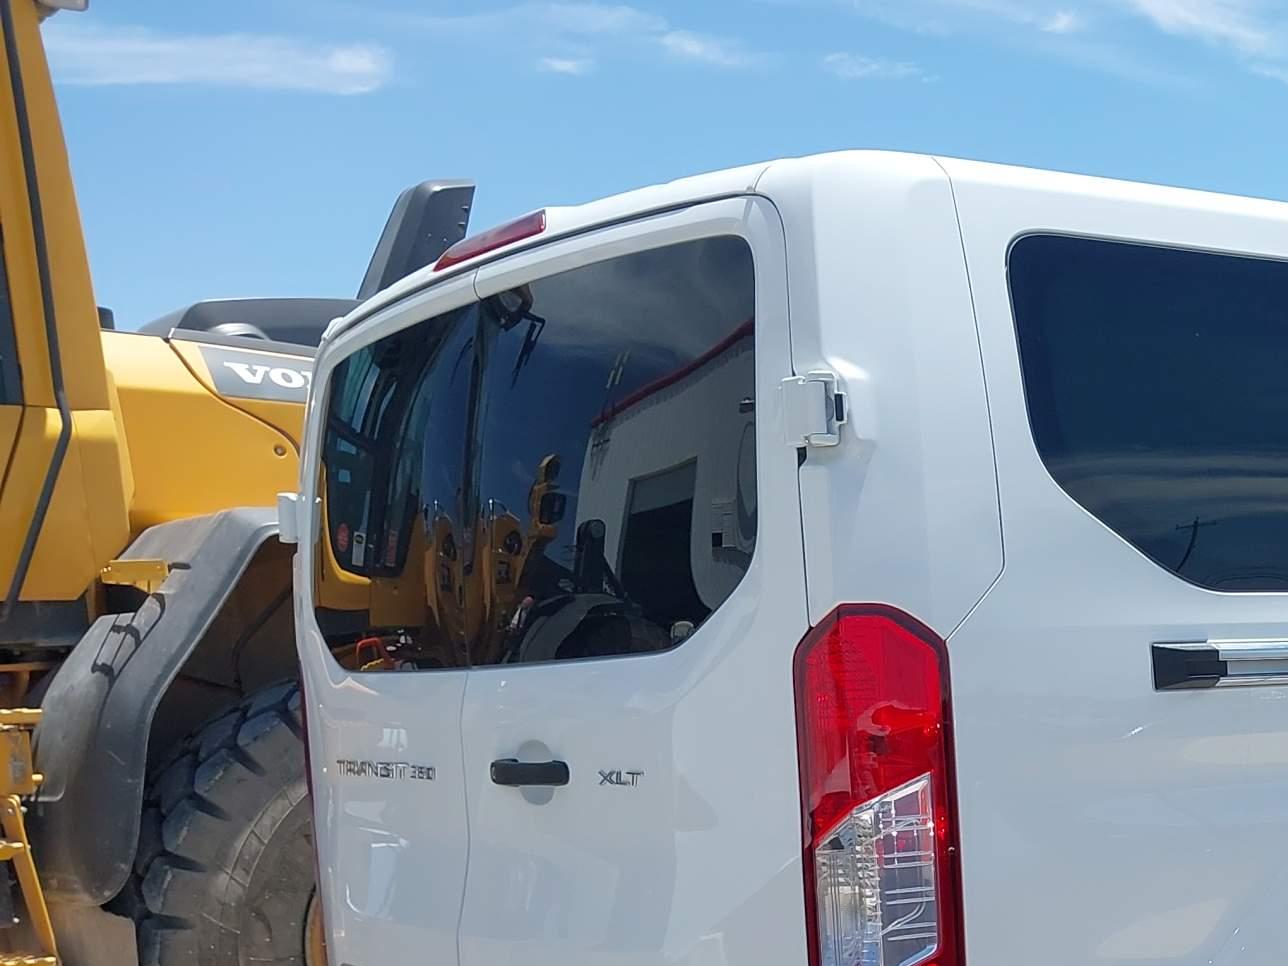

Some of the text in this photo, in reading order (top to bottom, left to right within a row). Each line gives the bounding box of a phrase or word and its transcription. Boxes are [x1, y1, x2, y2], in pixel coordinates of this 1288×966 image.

[336, 759, 437, 781] TRANSIT 350
[598, 769, 646, 787] XLT
